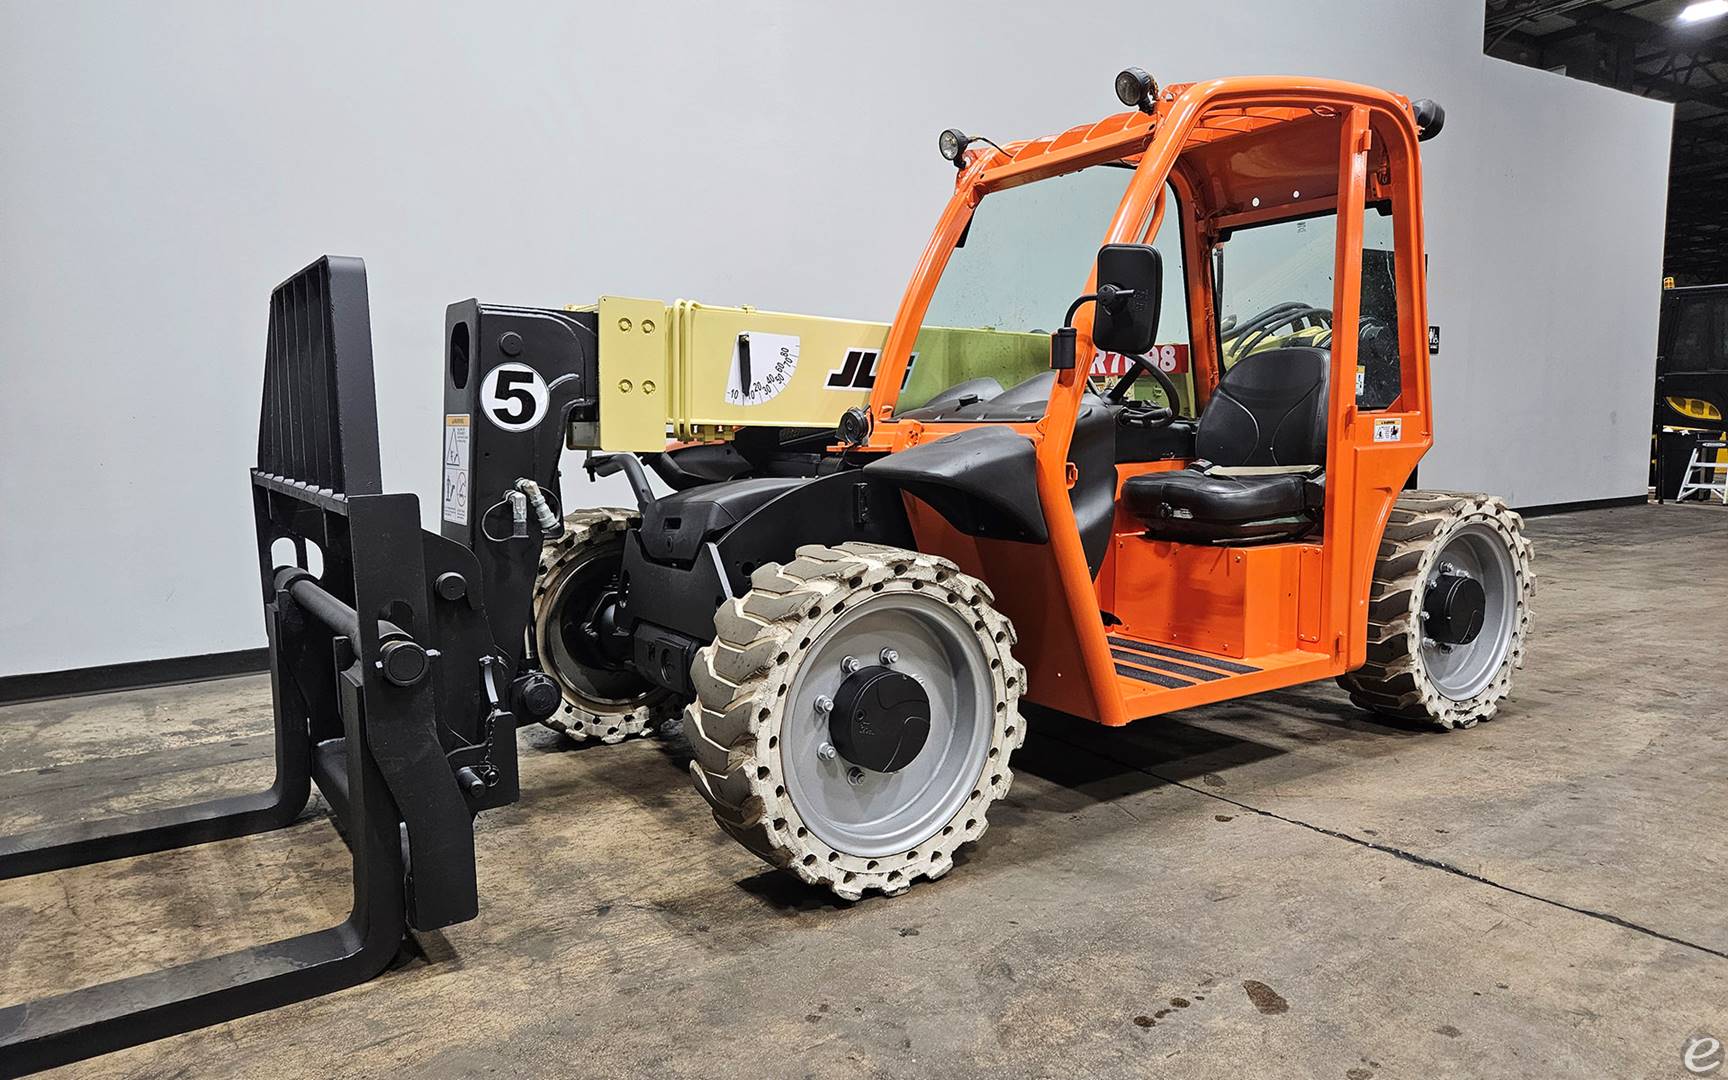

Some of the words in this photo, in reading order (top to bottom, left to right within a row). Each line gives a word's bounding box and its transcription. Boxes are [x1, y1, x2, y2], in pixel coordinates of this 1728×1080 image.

[780, 347, 789, 357] 80
[775, 362, 785, 373] 60
[783, 357, 793, 368] 70
[766, 373, 775, 384] 40
[775, 373, 785, 385] 50
[753, 381, 762, 392] 20
[762, 384, 772, 396] 30
[493, 370, 536, 424] 5
